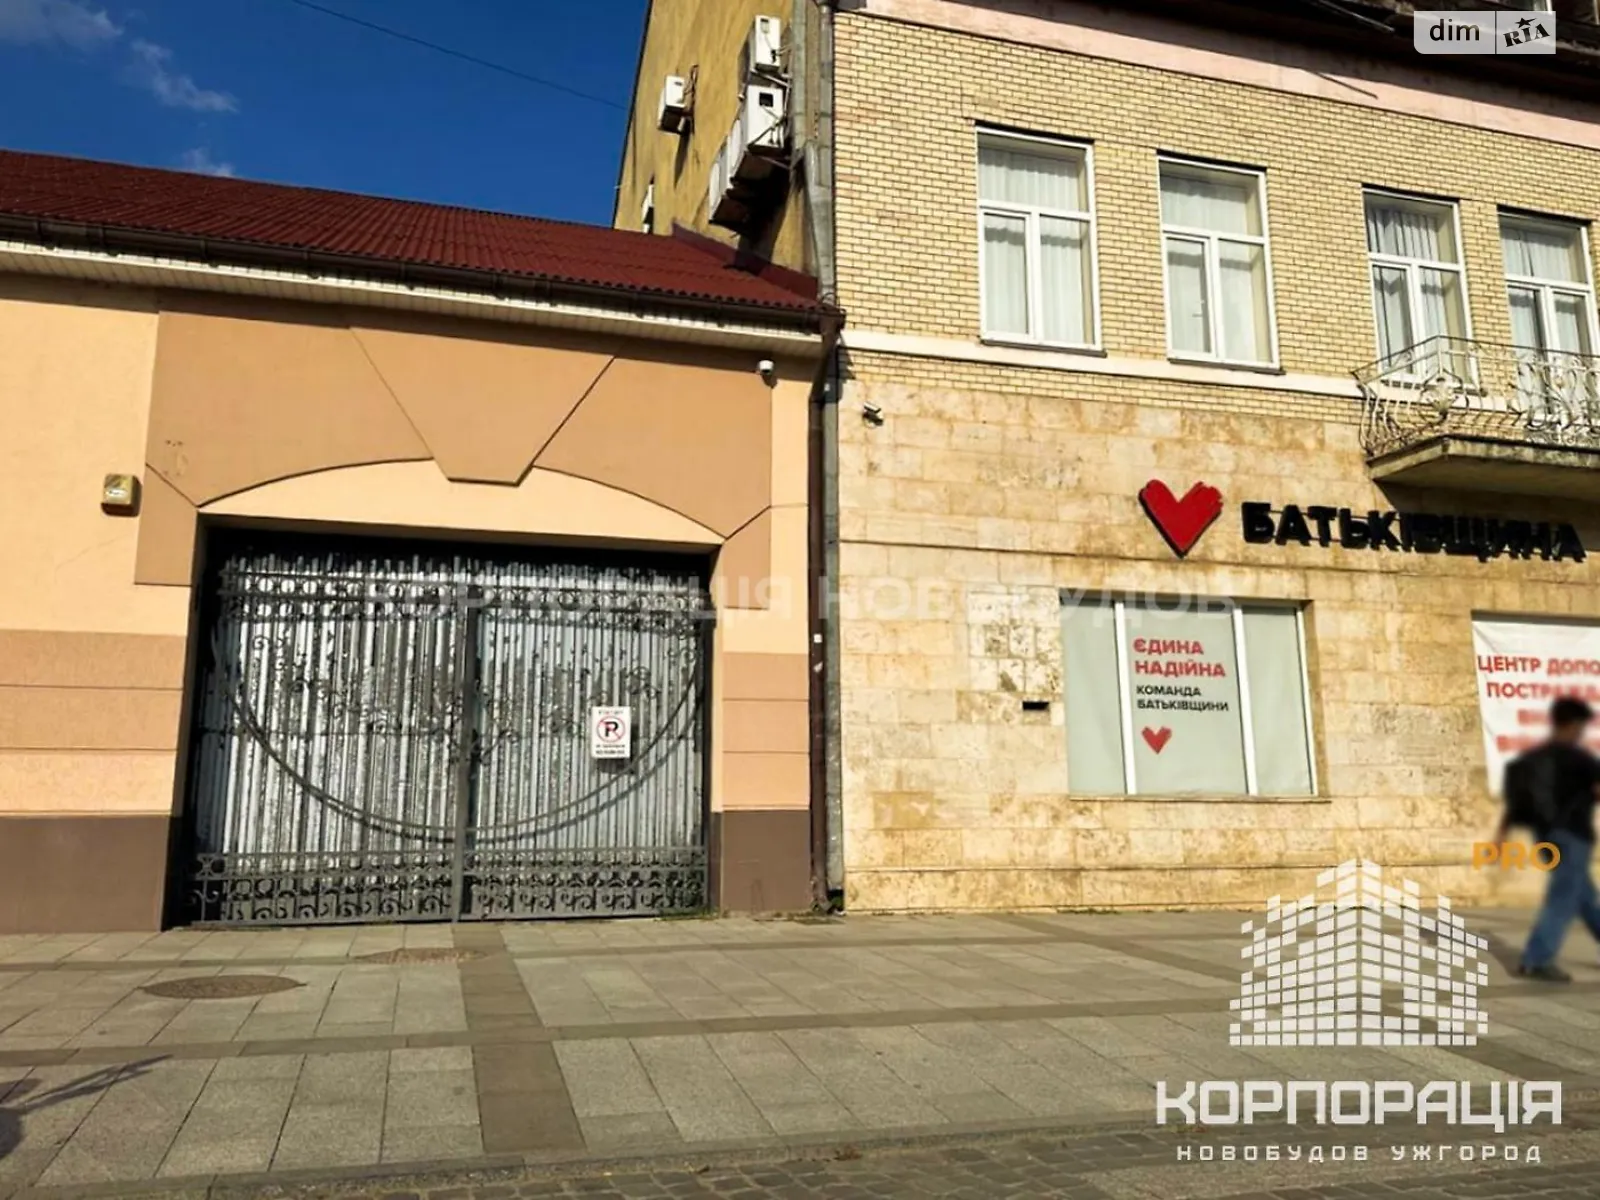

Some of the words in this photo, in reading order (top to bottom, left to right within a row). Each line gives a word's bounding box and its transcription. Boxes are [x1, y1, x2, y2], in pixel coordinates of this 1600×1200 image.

[1241, 501, 1587, 563] БАТЬКІВЩИНА
[1133, 638, 1204, 655] ЄДИНА
[1135, 659, 1226, 678] НАДІЙНА
[1477, 655, 1541, 673] ЦЕНТР
[1136, 684, 1202, 697] КОМАНДА
[1137, 699, 1229, 713] БАТЬКІВЩИНИ
